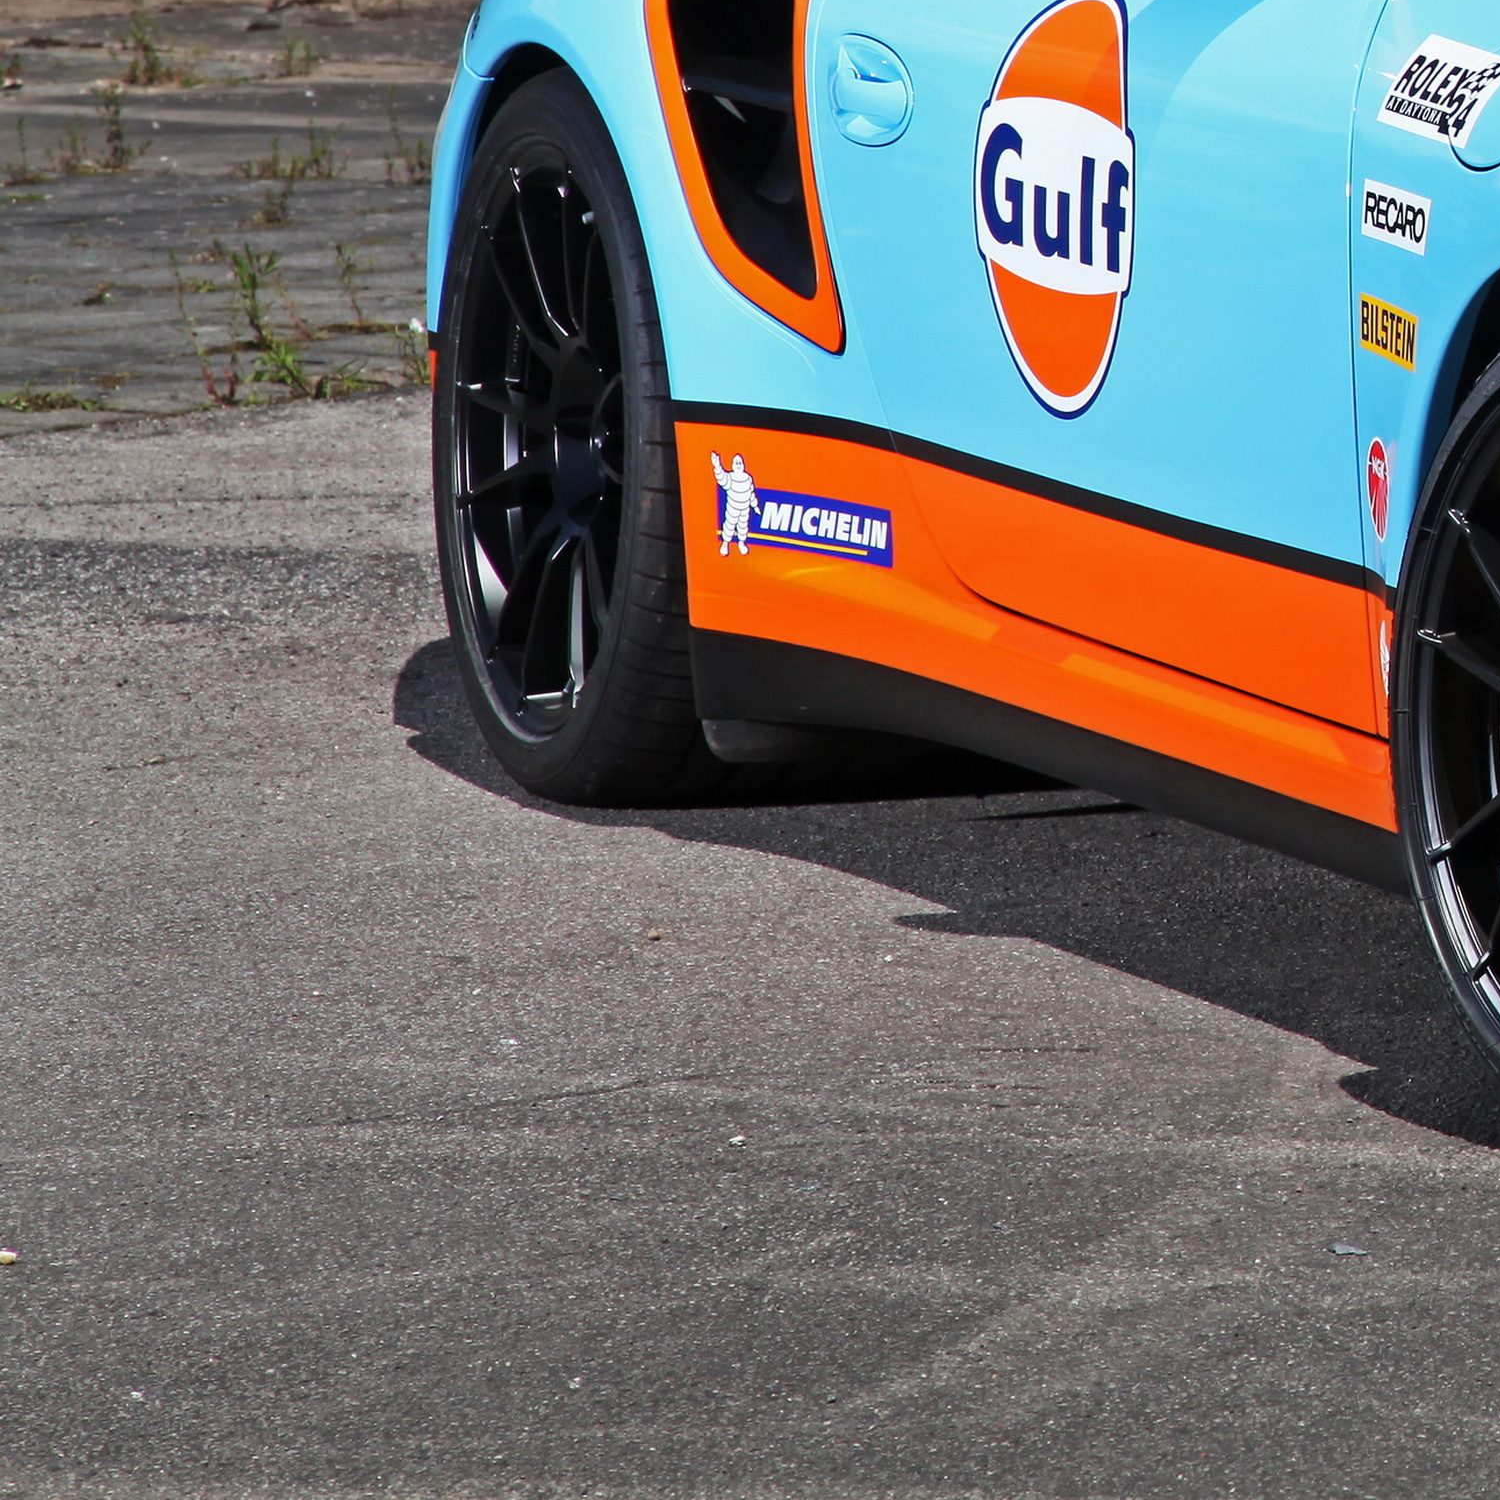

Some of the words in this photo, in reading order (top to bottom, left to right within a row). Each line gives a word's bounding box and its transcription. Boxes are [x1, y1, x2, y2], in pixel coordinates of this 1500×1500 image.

[1393, 54, 1477, 108] ROLEX
[1400, 101, 1443, 125] DAYTONA
[980, 122, 1130, 274] Gulf
[1364, 190, 1426, 244] RECARO
[1361, 299, 1416, 364] BILSTEIN
[760, 501, 888, 550] MICHELIN
